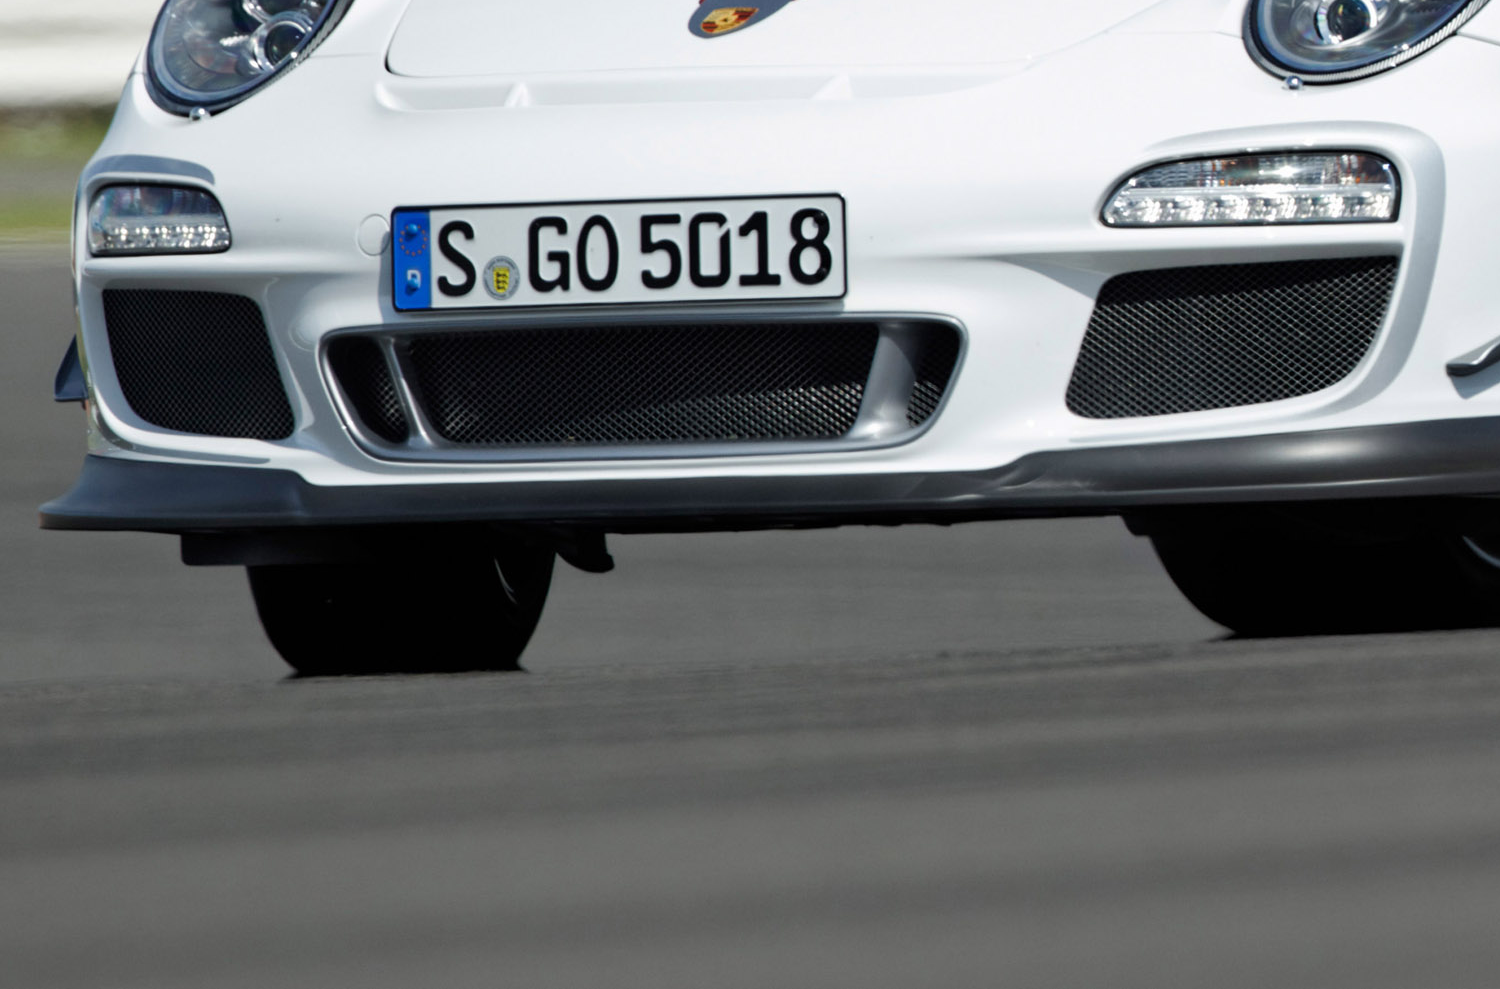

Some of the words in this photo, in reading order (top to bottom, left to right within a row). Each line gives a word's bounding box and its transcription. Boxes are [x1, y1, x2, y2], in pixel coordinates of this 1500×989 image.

[437, 220, 476, 297] S
[528, 214, 619, 293] GO
[640, 207, 832, 290] 5018
